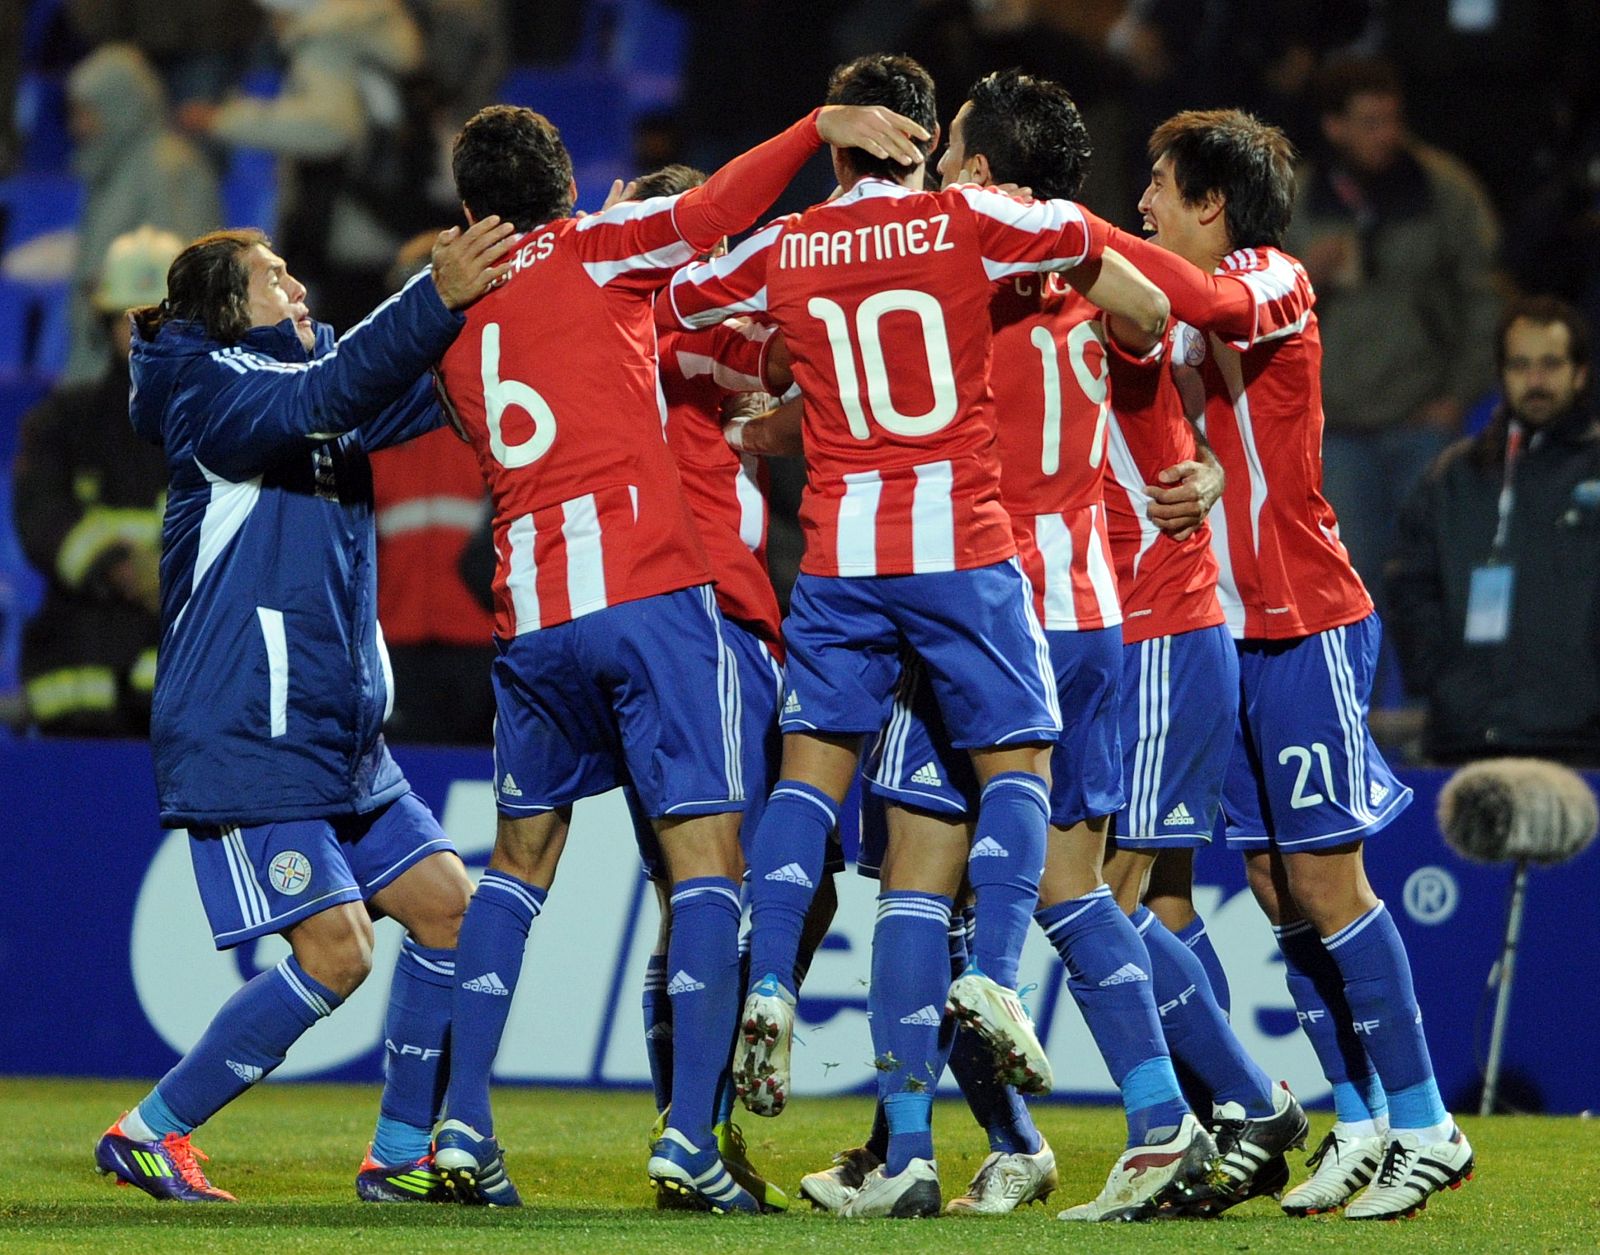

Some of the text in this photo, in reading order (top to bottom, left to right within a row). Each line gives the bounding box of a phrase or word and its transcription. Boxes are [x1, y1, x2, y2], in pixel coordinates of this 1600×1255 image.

[779, 213, 955, 270] MARTINEZ
[481, 322, 557, 469] 6
[807, 288, 957, 441] 10
[1030, 319, 1108, 476] 19
[1278, 742, 1337, 809] 21
[764, 873, 813, 889] adidas
[461, 981, 509, 997] adidas
[1098, 974, 1149, 988] adidas
